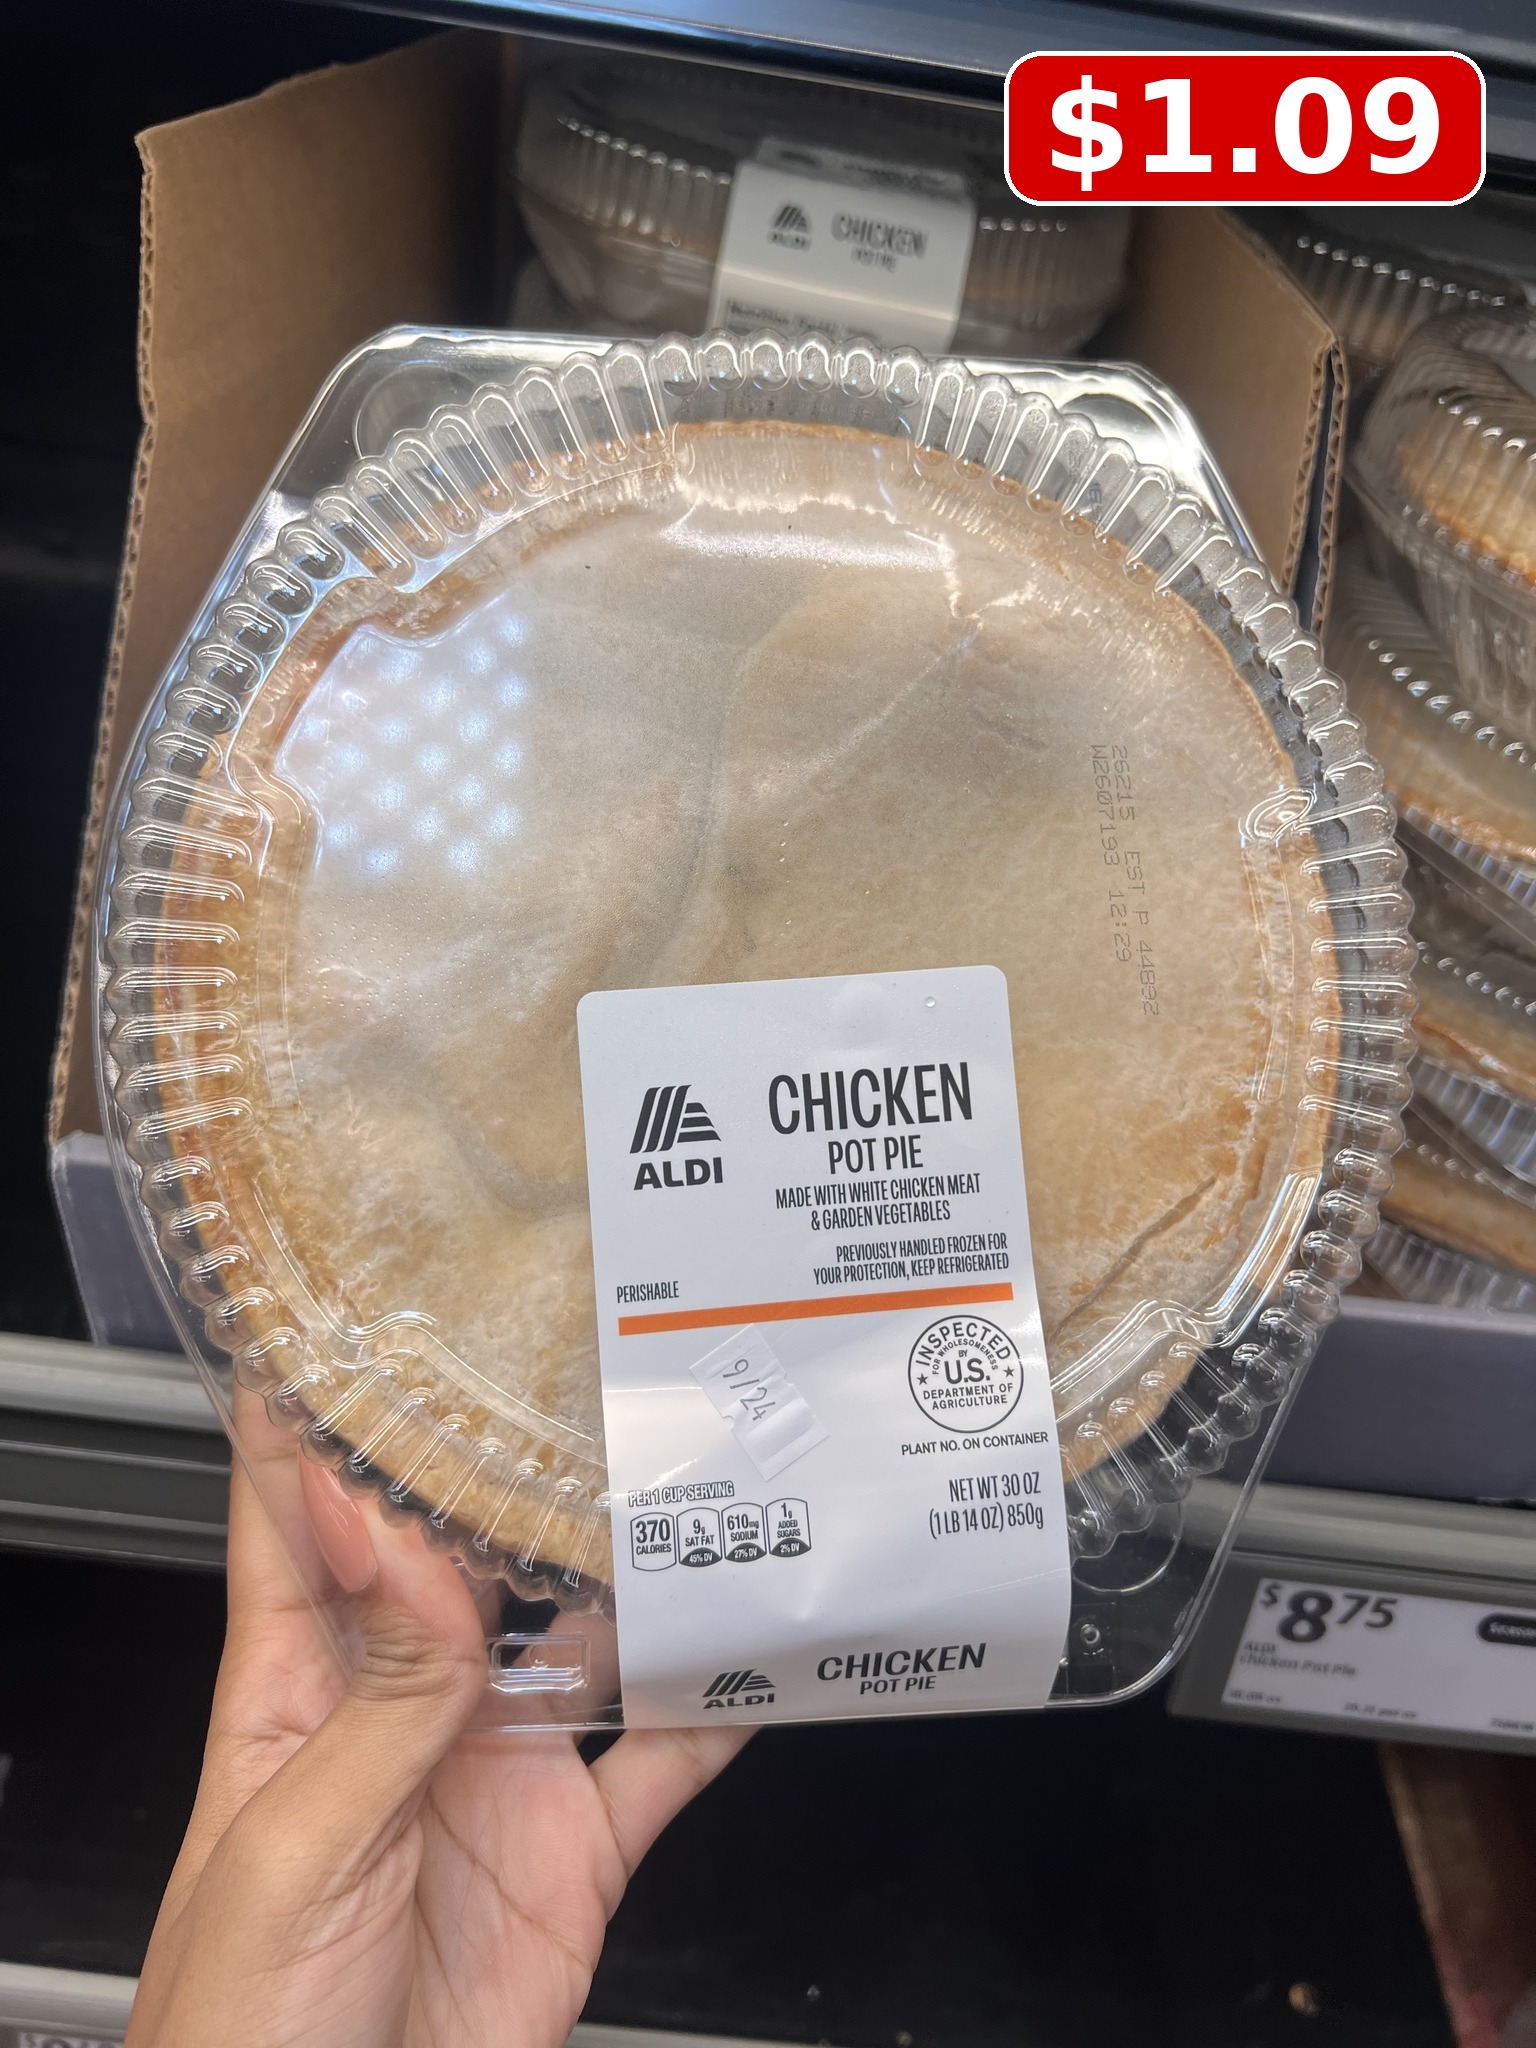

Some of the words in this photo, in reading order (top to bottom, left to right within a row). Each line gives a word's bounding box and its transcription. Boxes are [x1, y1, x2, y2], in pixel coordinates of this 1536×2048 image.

[830, 211, 929, 260] CHICKEN
[1110, 744, 1136, 821] 26215
[1123, 850, 1145, 895] EST
[1108, 889, 1132, 962] 12:29
[1131, 909, 1149, 925] P
[768, 1061, 973, 1135] CHICKEN
[827, 1138, 877, 1175] POT
[884, 1134, 924, 1169] PIE
[633, 1156, 724, 1191] ALDI
[775, 1186, 811, 1209] MADE
[813, 1183, 846, 1206] WITH
[848, 1180, 888, 1203] WHITE
[890, 1175, 945, 1200] CHICKEN
[947, 1173, 981, 1195] MEAT
[811, 1209, 821, 1231] &
[822, 1206, 873, 1229] GARDEN
[874, 1199, 951, 1226] VEGETABLES
[835, 1241, 898, 1263] PREVIOUSLY
[899, 1237, 946, 1258] HANDLED
[947, 1234, 986, 1254] FROZEN
[988, 1232, 1008, 1250] FOR
[813, 1266, 842, 1285] YOUR
[843, 1261, 910, 1283] PROTECTION,
[911, 1258, 936, 1277] KEEP
[937, 1252, 1010, 1275] REFRIGERATED
[616, 1281, 680, 1304] PERISHABLE
[915, 1321, 1011, 1367] INSPECTED
[932, 1358, 942, 1375] FOR
[937, 1338, 999, 1371] WHOLESOMENESS
[958, 1349, 968, 1358] BY
[944, 1357, 991, 1385] U.S.
[722, 1358, 776, 1421] 9/24
[923, 1384, 995, 1400] DEPARTMENT
[998, 1383, 1013, 1393] OF
[932, 1394, 1008, 1410] AGRICULTURE
[901, 1441, 937, 1456] PLANT
[940, 1440, 961, 1452] NO.
[963, 1438, 981, 1450] ON
[983, 1431, 1049, 1448] CONTAINER
[628, 1489, 652, 1507] PER
[652, 1489, 660, 1504] 1
[662, 1486, 685, 1503] CUP
[685, 1480, 735, 1501] SERVING
[948, 1477, 974, 1502] NET
[976, 1475, 998, 1499] WT
[1001, 1473, 1020, 1497] 30
[1023, 1471, 1041, 1495] OZ
[635, 1518, 671, 1543] 370
[776, 1528, 801, 1539] SUGARS
[777, 1519, 798, 1529] ADDED
[929, 1508, 942, 1540] (1
[943, 1510, 960, 1534] LB
[962, 1508, 978, 1532] 14
[981, 1501, 1004, 1532] OZ)
[1007, 1502, 1044, 1530] 850g
[636, 1543, 672, 1555] CALORIES
[685, 1535, 701, 1547] SAT
[701, 1534, 715, 1546] FAT
[730, 1530, 759, 1542] SODIUM
[791, 1542, 800, 1552] DV
[688, 1553, 703, 1563] 45%
[703, 1552, 713, 1562] DV
[733, 1548, 748, 1559] 27%
[748, 1547, 758, 1558] DV
[816, 1642, 987, 1681] CHICKEN
[859, 1678, 901, 1695] POT
[904, 1675, 937, 1692] PIE
[702, 1692, 776, 1710] ALDI
